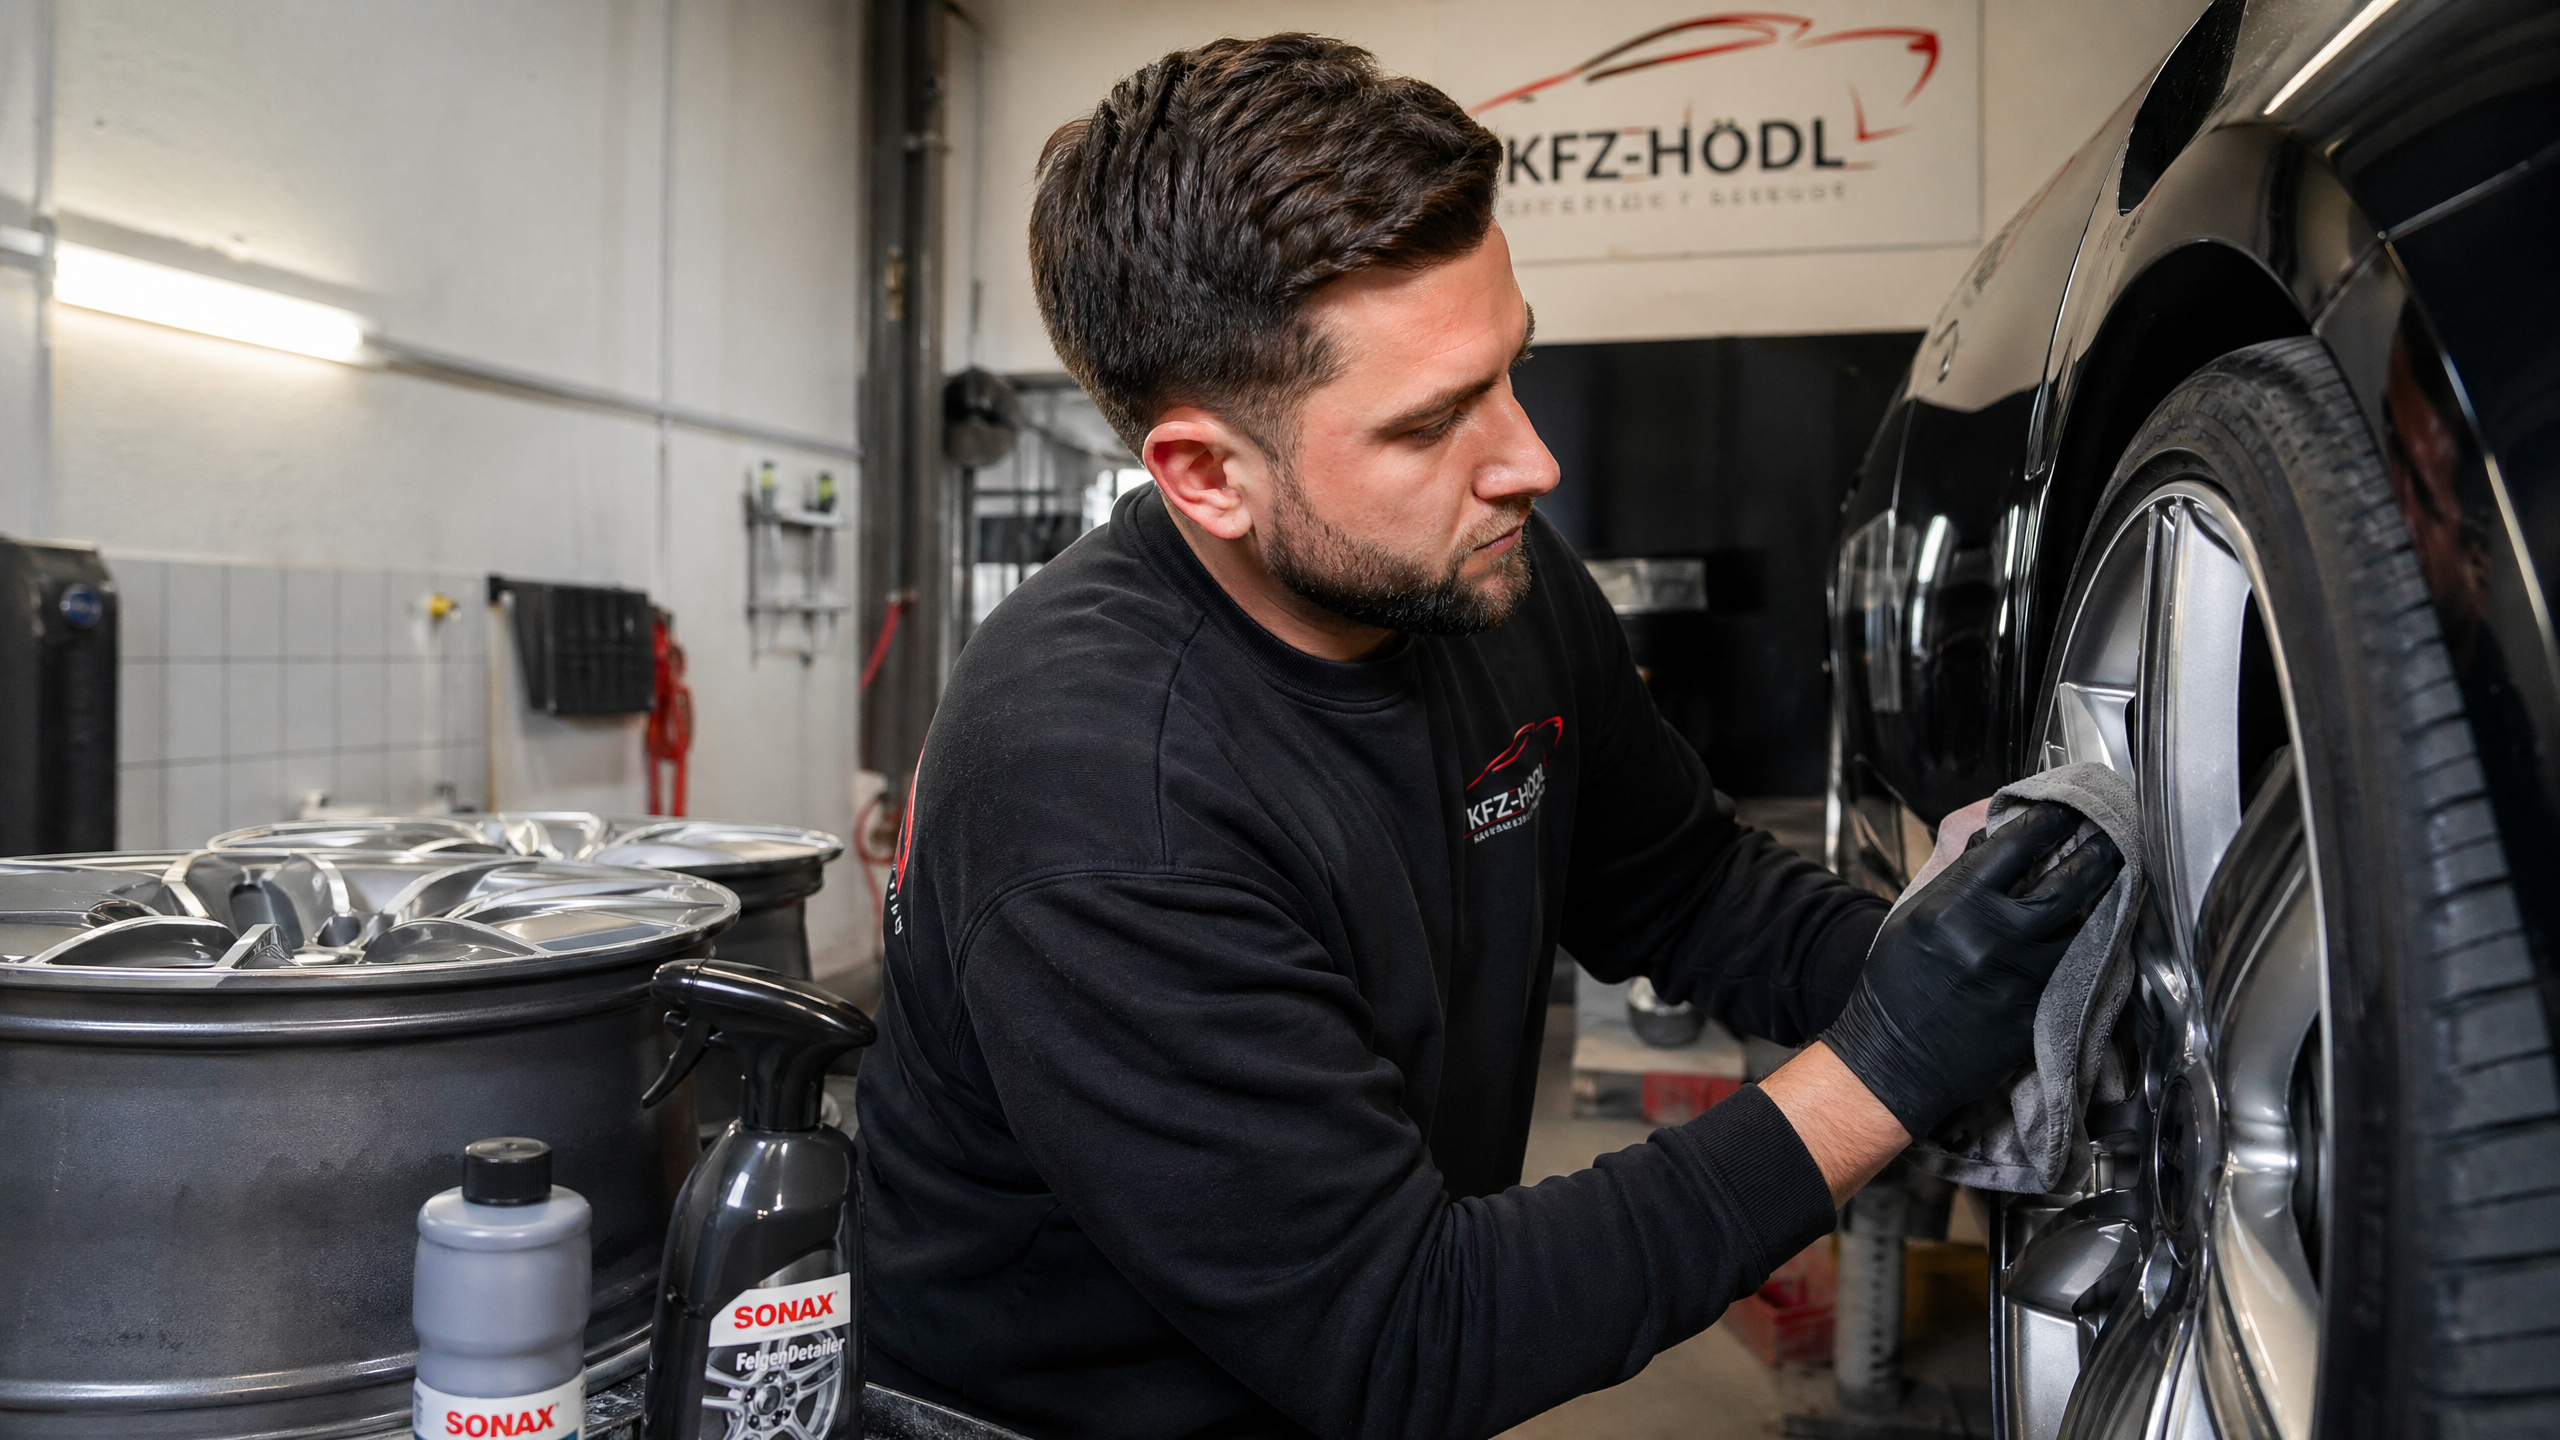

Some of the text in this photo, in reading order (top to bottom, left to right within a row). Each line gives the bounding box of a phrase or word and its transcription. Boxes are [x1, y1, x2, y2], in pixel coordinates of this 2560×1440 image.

[1508, 116, 1845, 185] KFZ-HÖDL
[733, 1291, 834, 1330] SONAX
[735, 1337, 846, 1372] FelgenDetailer
[444, 1403, 555, 1438] SONAX
